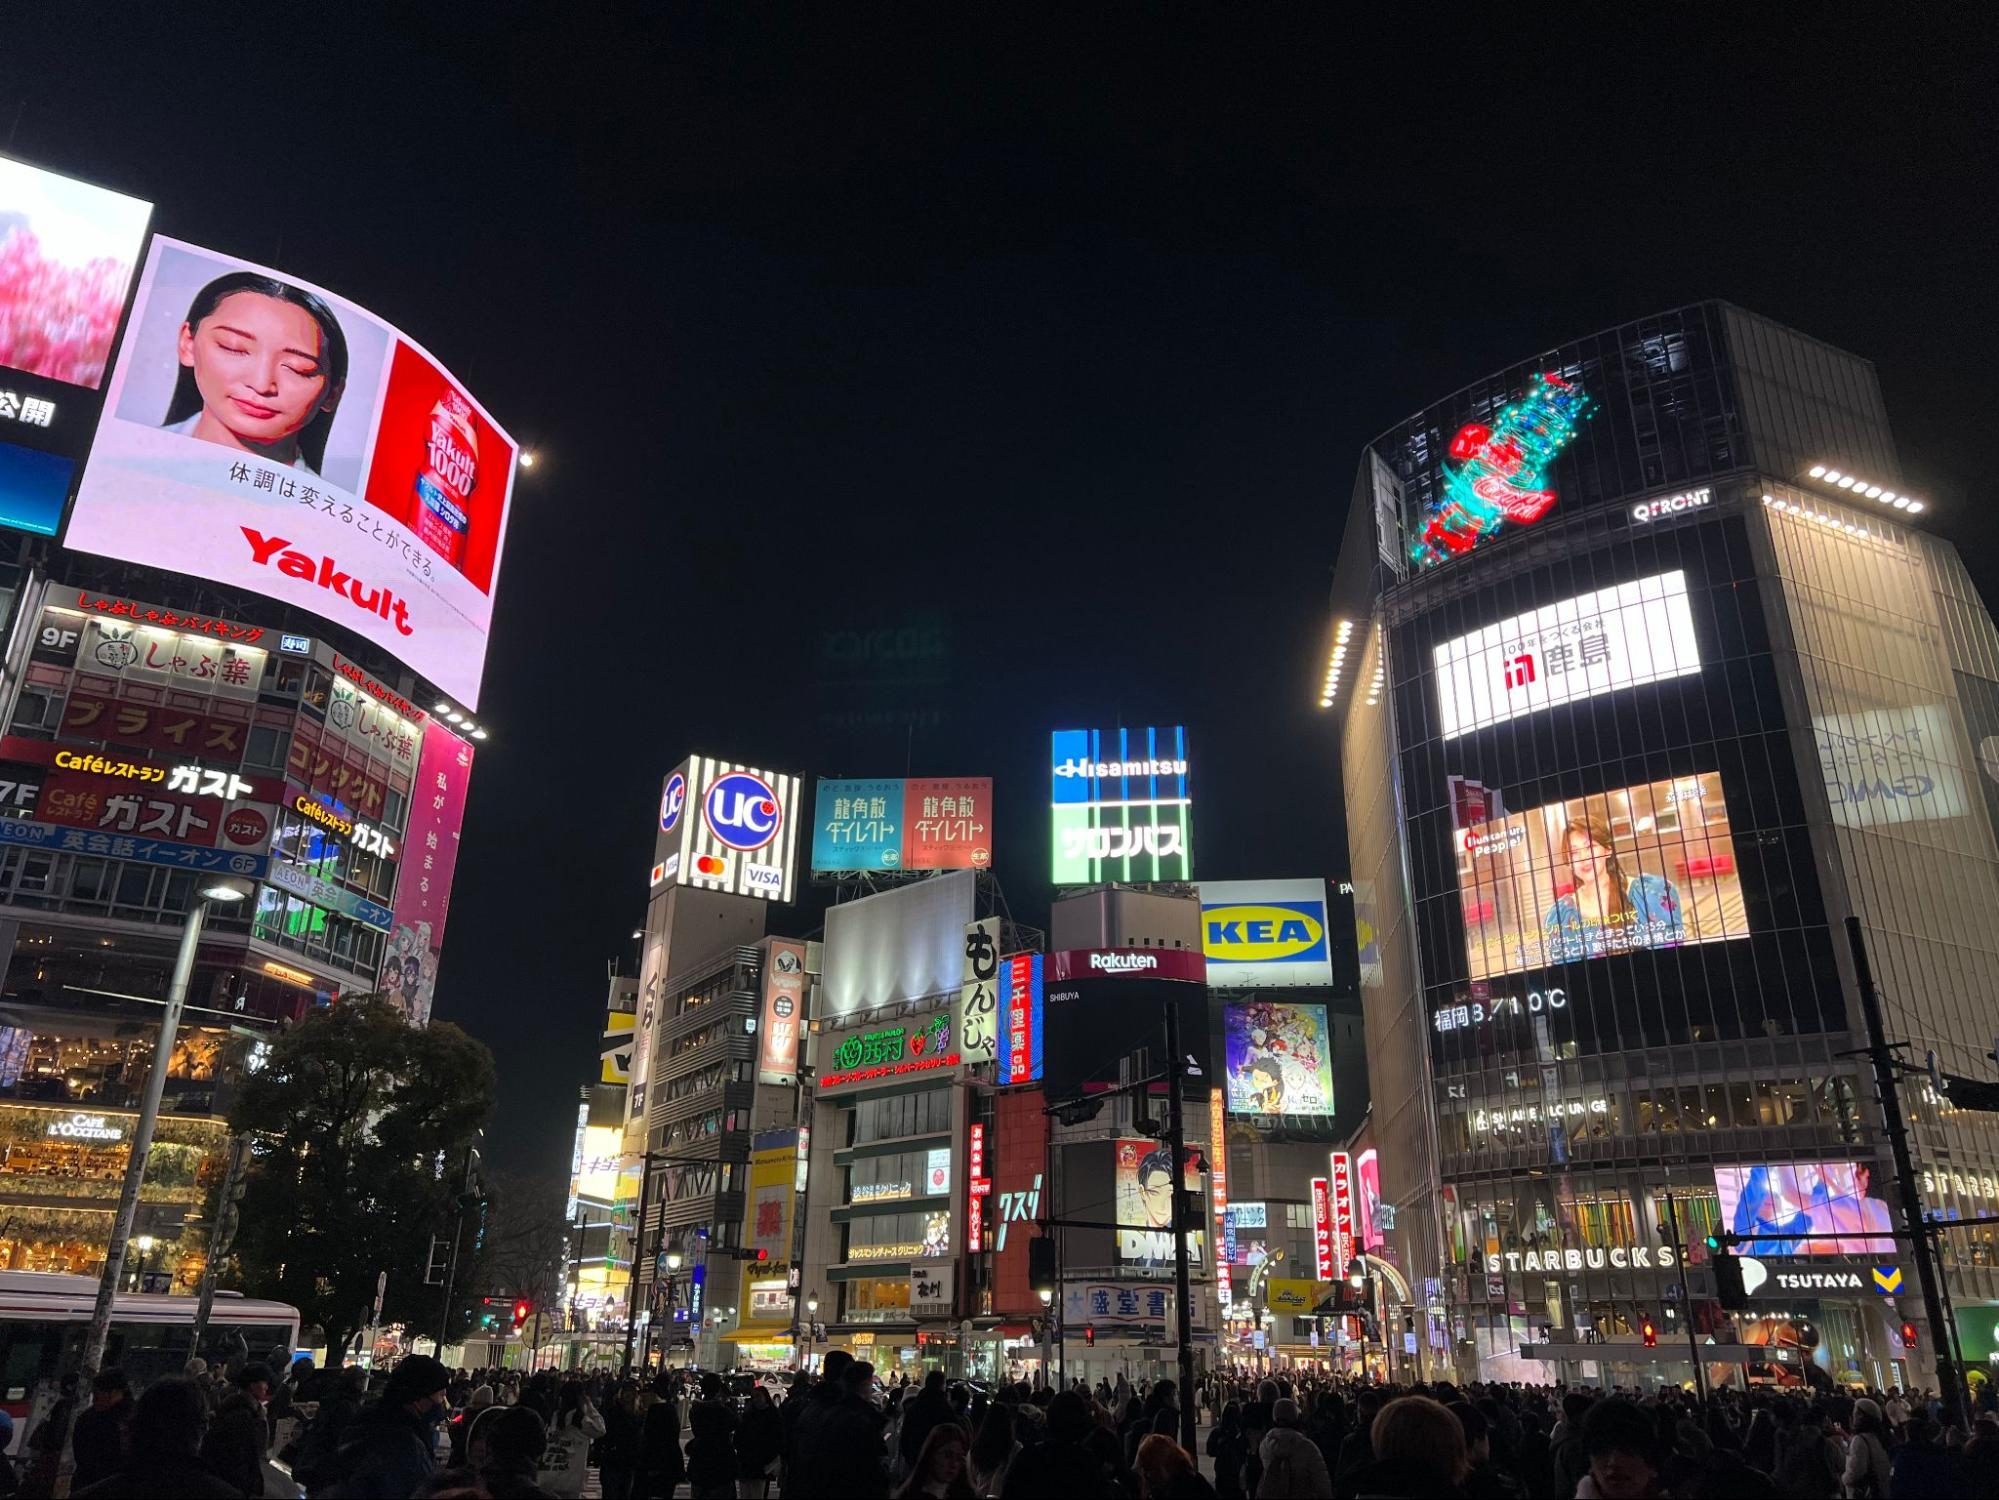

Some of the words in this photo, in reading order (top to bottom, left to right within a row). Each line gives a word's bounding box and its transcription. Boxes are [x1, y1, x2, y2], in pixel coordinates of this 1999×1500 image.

[431, 420, 475, 479] Yakult
[428, 442, 471, 496] 1000
[228, 461, 437, 582] 体調は変えることができる。
[1634, 489, 1711, 522] QFRONT
[240, 525, 414, 637] Yakult
[79, 592, 265, 643] しゃぶしゃぶバイキング
[41, 627, 77, 648] 9F
[146, 642, 250, 685] しゃぶ葉
[1542, 633, 1611, 678] 鹿島
[68, 702, 238, 752] プライス
[357, 708, 414, 762] しゃぶ葉
[168, 765, 253, 800] ガスト
[291, 739, 383, 809] コンタクト
[1054, 759, 1187, 778] Hisamitsu
[0, 780, 39, 805] 7F
[49, 789, 97, 809] Café
[662, 785, 684, 819] UC
[834, 796, 886, 820] 龍角散
[923, 795, 975, 818] 龍角散
[99, 795, 208, 838] ガスト
[713, 788, 774, 832] UC
[1, 822, 43, 841] EON
[229, 824, 262, 836] ガスト
[352, 822, 395, 859] ガスト
[419, 772, 447, 907] 私が、始まる。
[825, 821, 894, 843] ダイレクト
[915, 820, 984, 841] ダイレクト
[1061, 825, 1184, 859] サロンパス
[61, 831, 222, 867] 英会話イーオン
[232, 854, 257, 871] 6F
[275, 868, 307, 890] AEON
[748, 869, 780, 886] VISA
[1208, 920, 1313, 945] KEA
[1091, 953, 1157, 971] Rakuten
[963, 924, 997, 1057] もんじゃ
[1050, 992, 1080, 1002] SHIBUYA
[1335, 1163, 1351, 1225] カラオケ
[997, 1174, 1043, 1252] クスリ
[1318, 1230, 1332, 1281] カラオ
[1488, 1246, 1676, 1273] STARBUCKS
[1777, 1273, 1863, 1290] TSUTAYA
